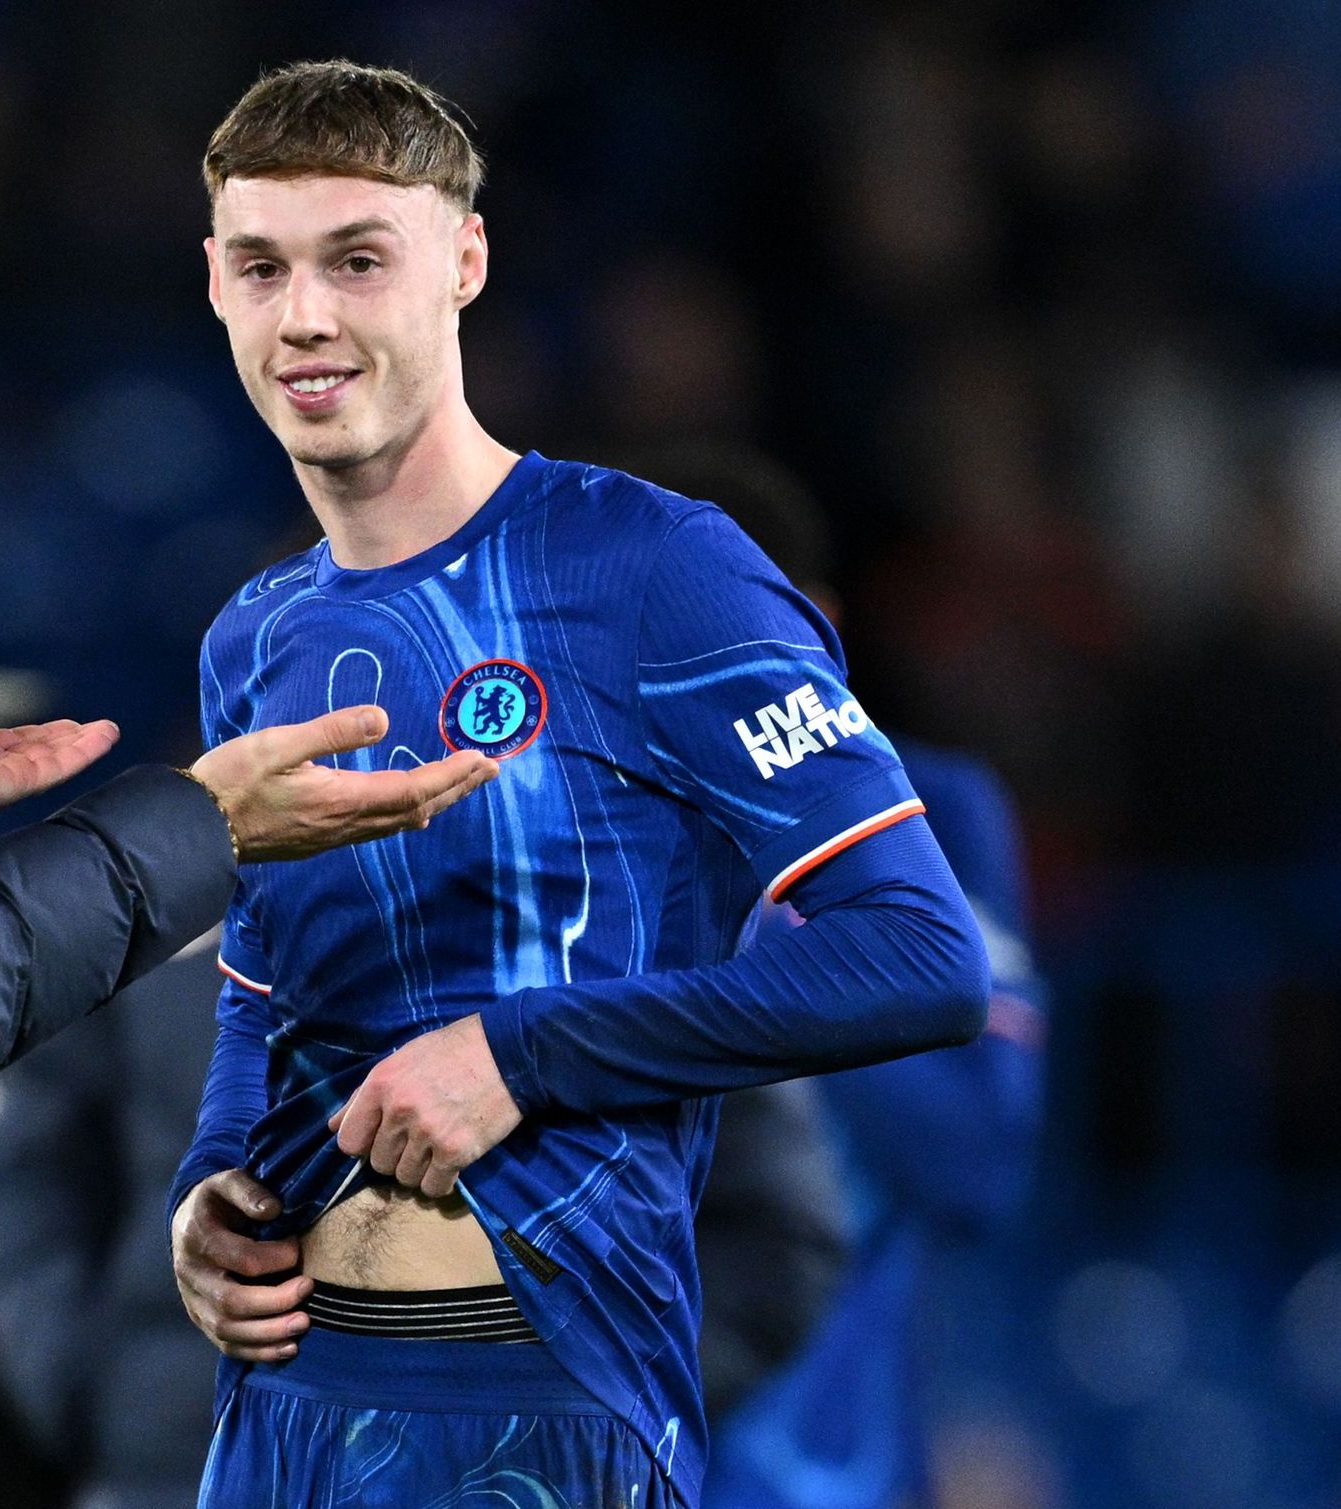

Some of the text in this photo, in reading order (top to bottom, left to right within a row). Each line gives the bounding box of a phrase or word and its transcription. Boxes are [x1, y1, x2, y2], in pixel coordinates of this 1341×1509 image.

[463, 665, 527, 686] CHELSEA
[733, 682, 826, 752] LIVE
[455, 736, 521, 755] FOOTLL CLUB
[749, 700, 872, 780] NATIO
